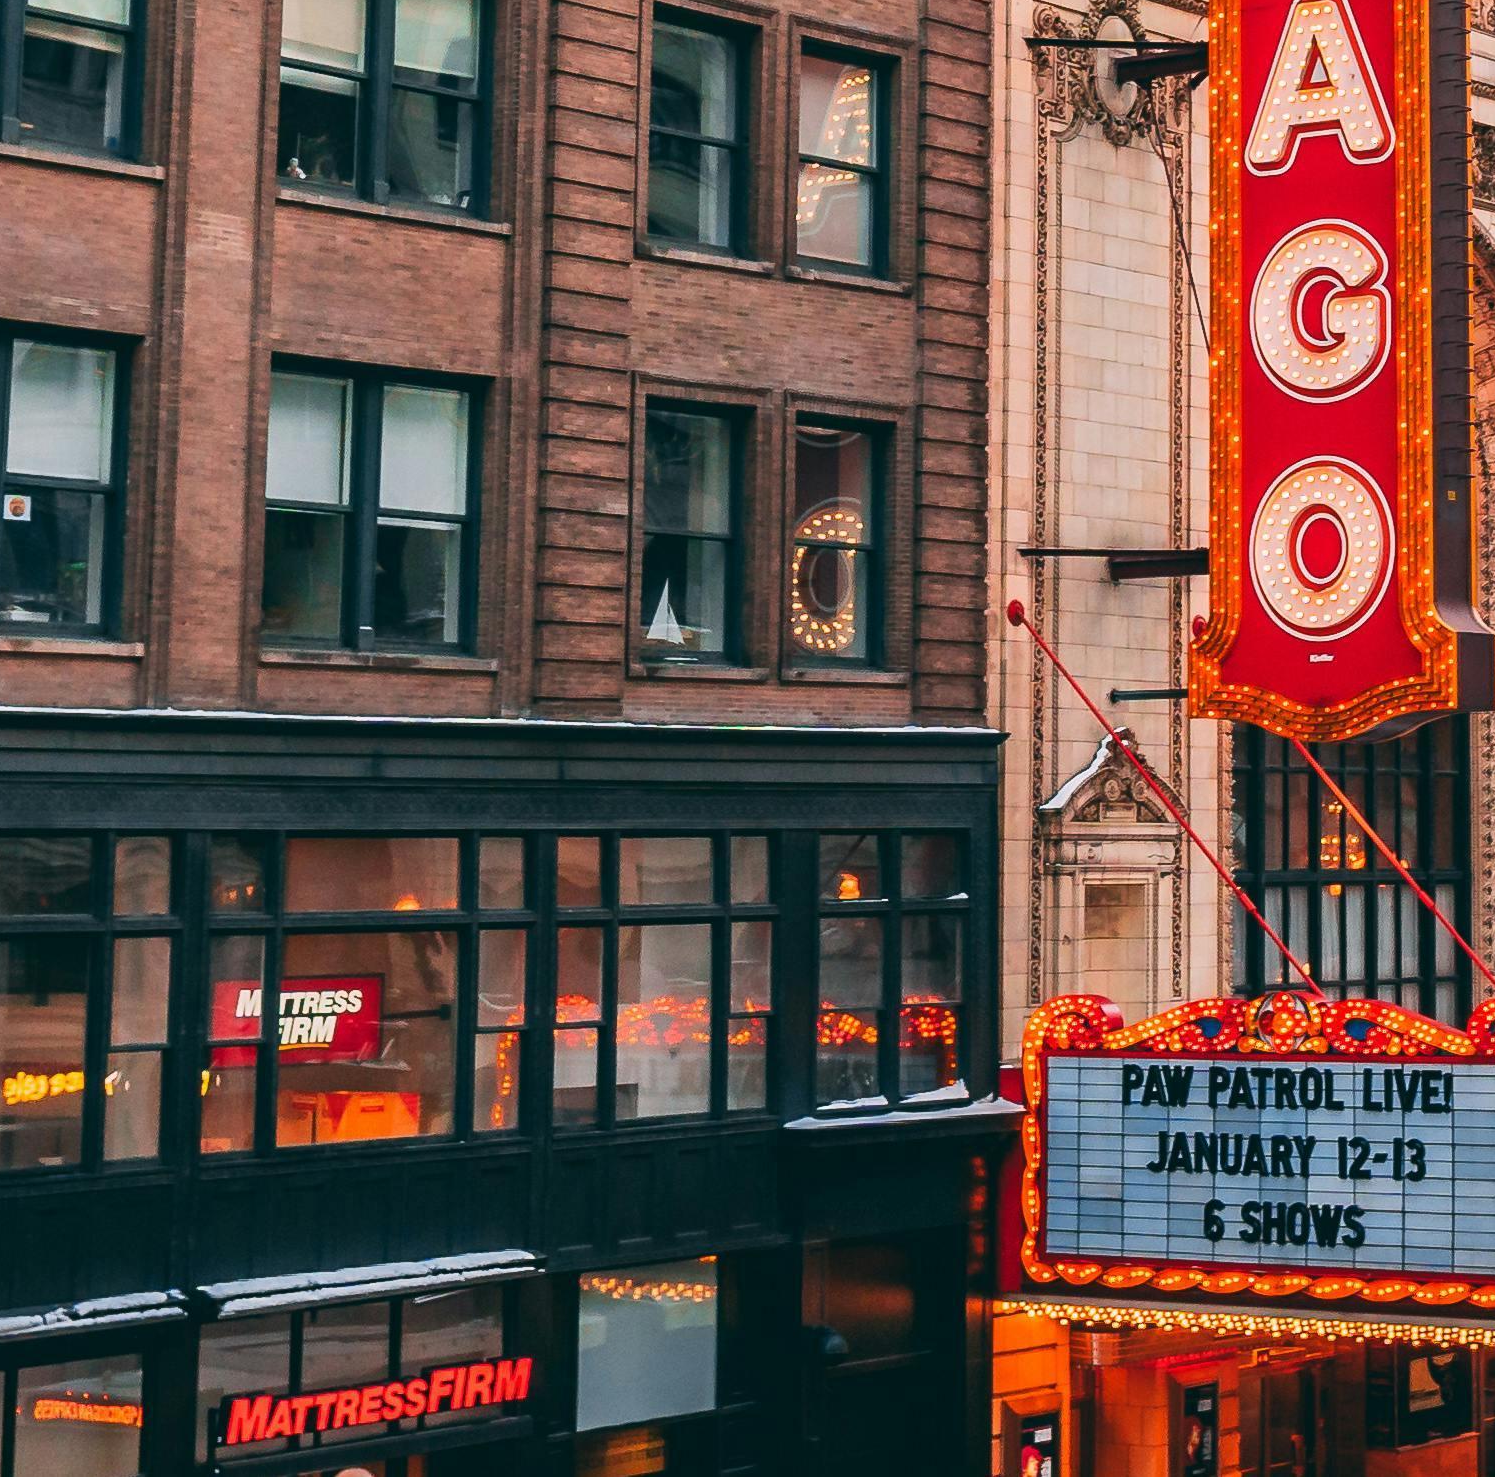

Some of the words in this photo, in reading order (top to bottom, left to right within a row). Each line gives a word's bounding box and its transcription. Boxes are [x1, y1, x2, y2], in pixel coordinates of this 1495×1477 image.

[235, 989, 363, 1018] MTTRESS
[1121, 1063, 1194, 1108] PAW
[1208, 1066, 1345, 1111] PATROL
[1362, 1068, 1453, 1114] LIVE!
[1146, 1130, 1316, 1179] JANUARY
[1337, 1136, 1426, 1183] 12-13
[1203, 1198, 1226, 1243] 6
[1239, 1200, 1366, 1248] SHOWS
